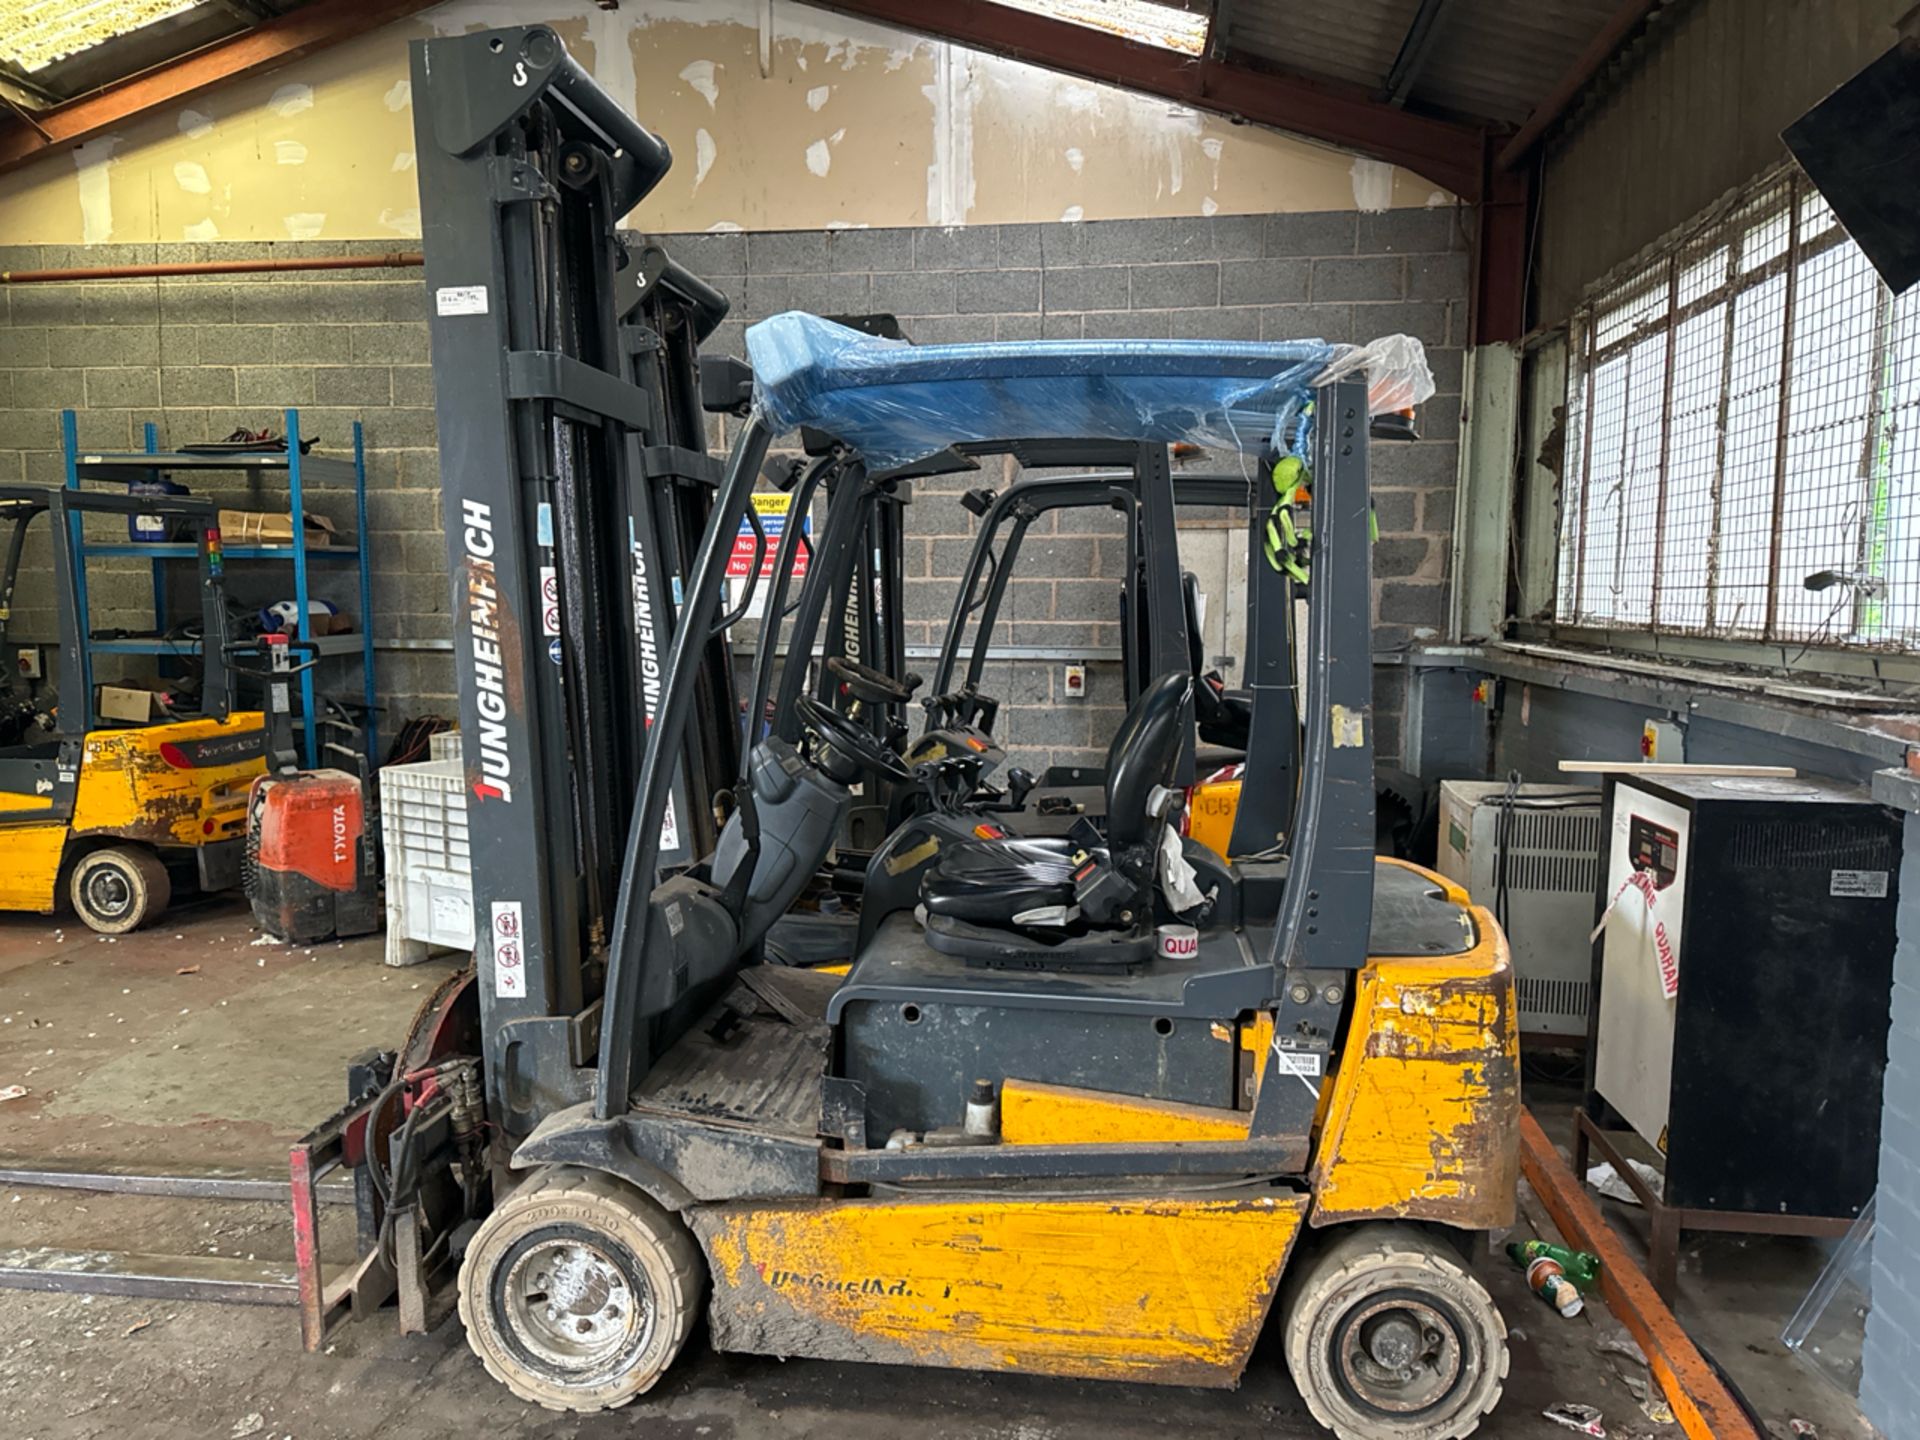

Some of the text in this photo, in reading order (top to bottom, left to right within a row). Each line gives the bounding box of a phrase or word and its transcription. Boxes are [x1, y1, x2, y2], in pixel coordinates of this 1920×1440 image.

[738, 541, 753, 550] No
[732, 561, 747, 570] No
[333, 804, 347, 863] TOYOTA
